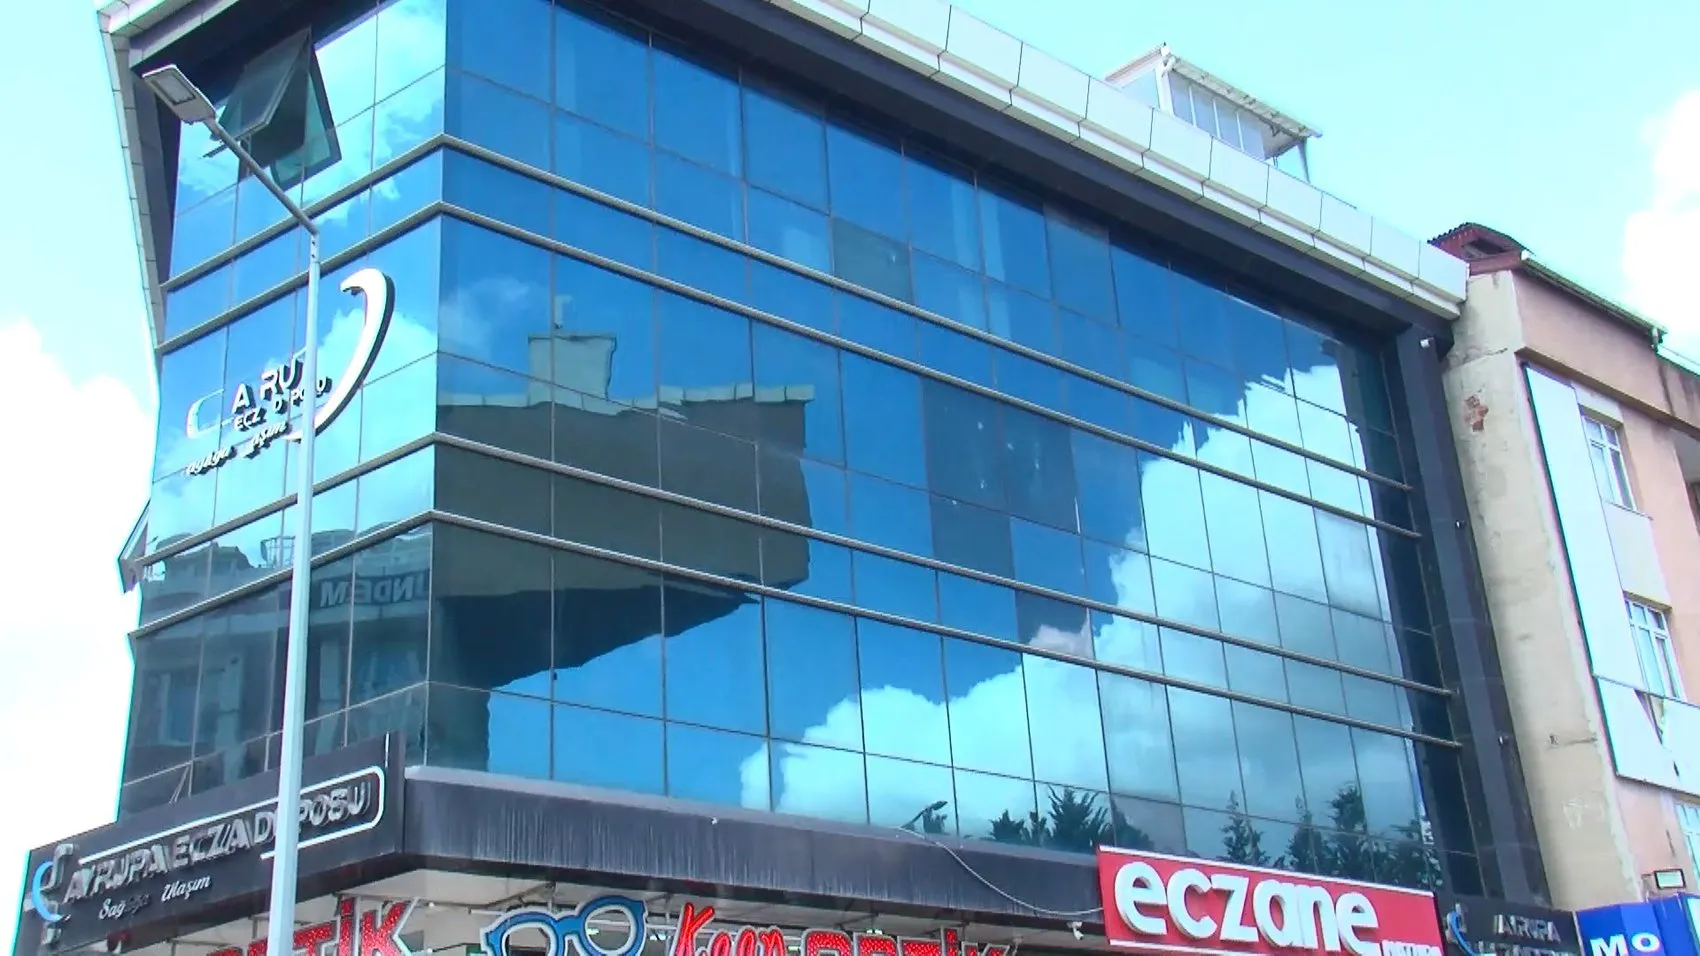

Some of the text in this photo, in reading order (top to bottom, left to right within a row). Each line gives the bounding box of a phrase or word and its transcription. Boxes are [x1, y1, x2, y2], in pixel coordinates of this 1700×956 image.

[254, 782, 371, 844] DPOSU
[161, 875, 212, 903] Ulaşım
[1114, 861, 1380, 955] eczane
